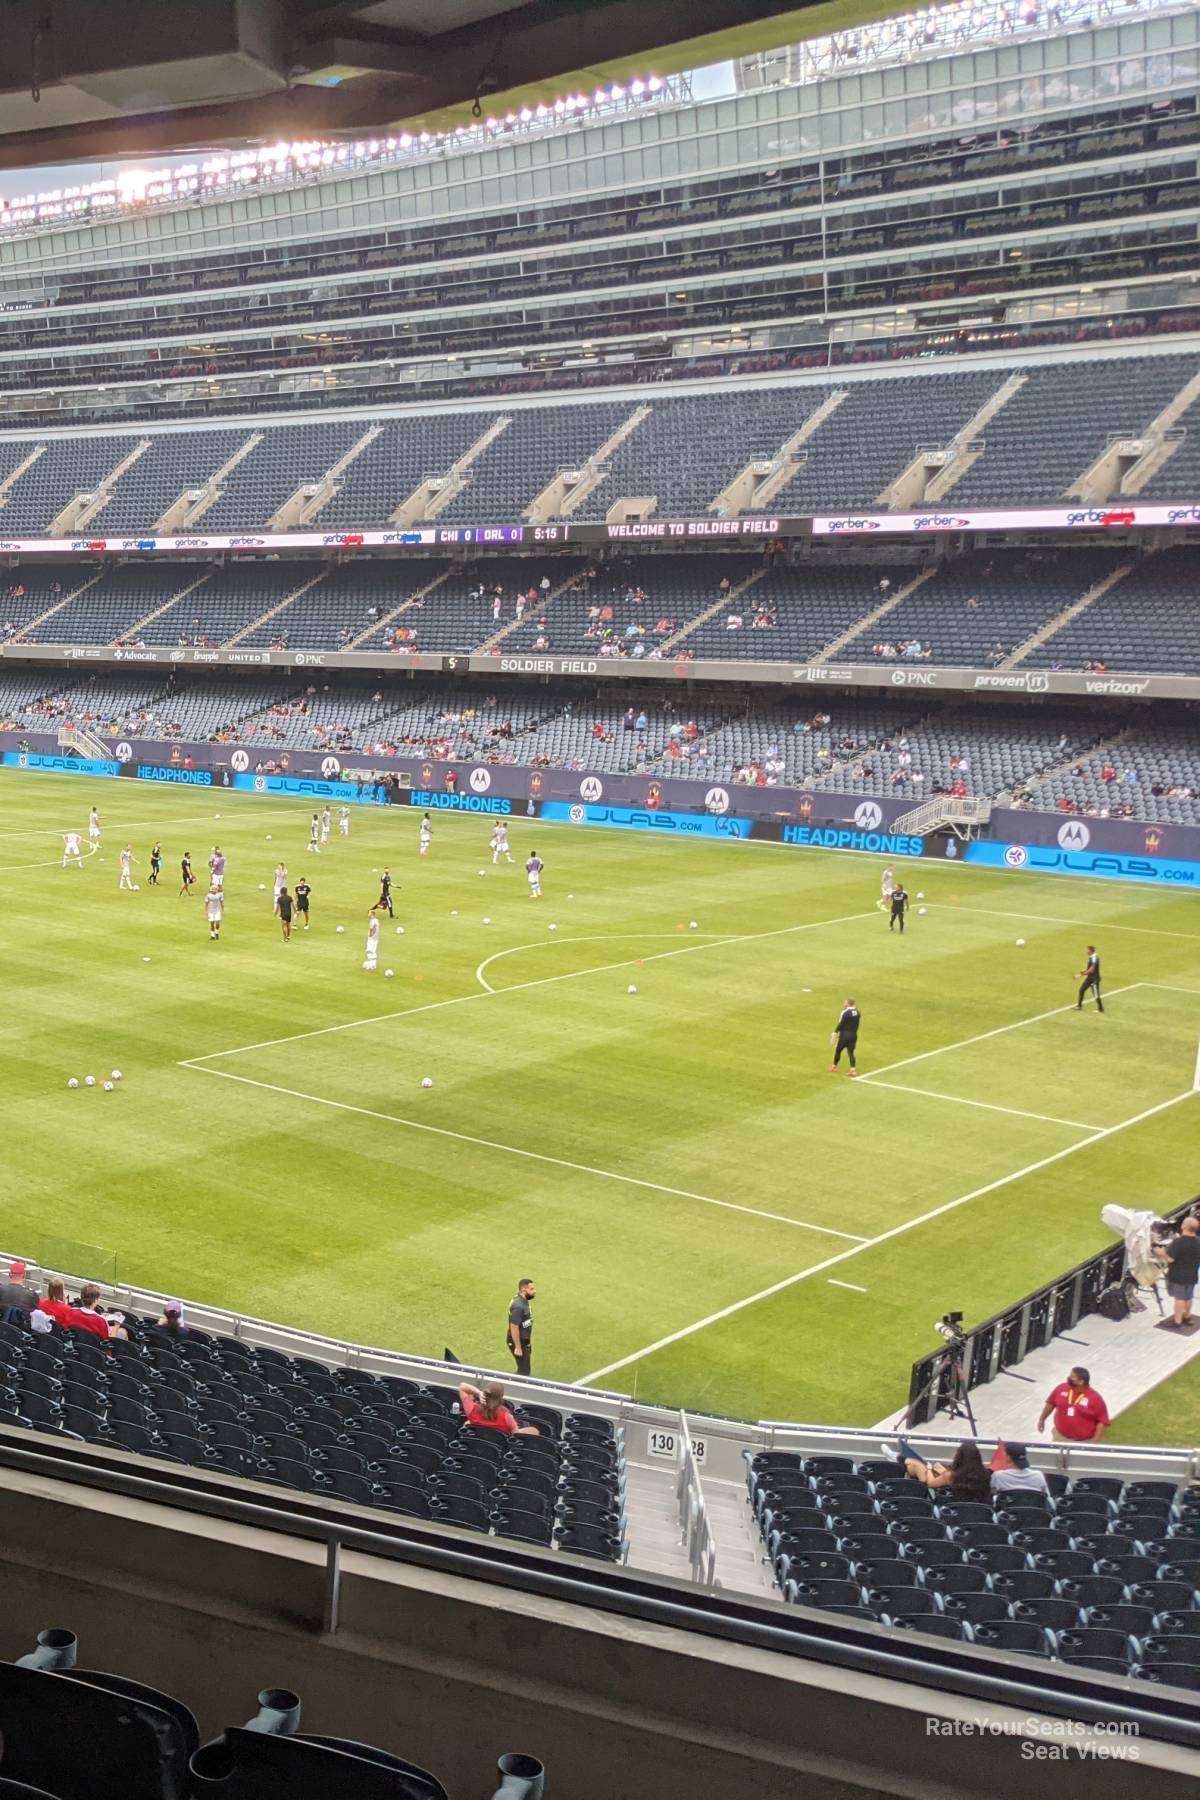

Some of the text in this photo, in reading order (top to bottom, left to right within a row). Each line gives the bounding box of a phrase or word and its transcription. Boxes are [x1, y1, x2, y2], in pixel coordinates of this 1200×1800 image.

[607, 520, 779, 537] WELCOME TO SOLDIER FIELD
[828, 518, 867, 532] gerber
[913, 514, 956, 531] gerber
[441, 529, 471, 542] CHI 0
[484, 529, 518, 541] ORL 0
[534, 527, 558, 540] 5:15
[175, 536, 201, 549] gerber
[229, 535, 256, 548] gerber
[124, 650, 157, 660] Advocate
[193, 651, 219, 662] Snapple
[228, 653, 261, 662] UNITED
[306, 655, 325, 664] PNC
[500, 659, 597, 673] SOLDIER FIELD
[908, 672, 936, 685] PNC
[974, 674, 1025, 688] proven
[1086, 680, 1143, 694] verizon
[137, 765, 212, 786] HEADPHONES
[410, 790, 511, 815] HEADPHONES
[783, 825, 924, 857] HEADPHONES
[651, 1432, 674, 1451] 130
[691, 1440, 705, 1457] 28
